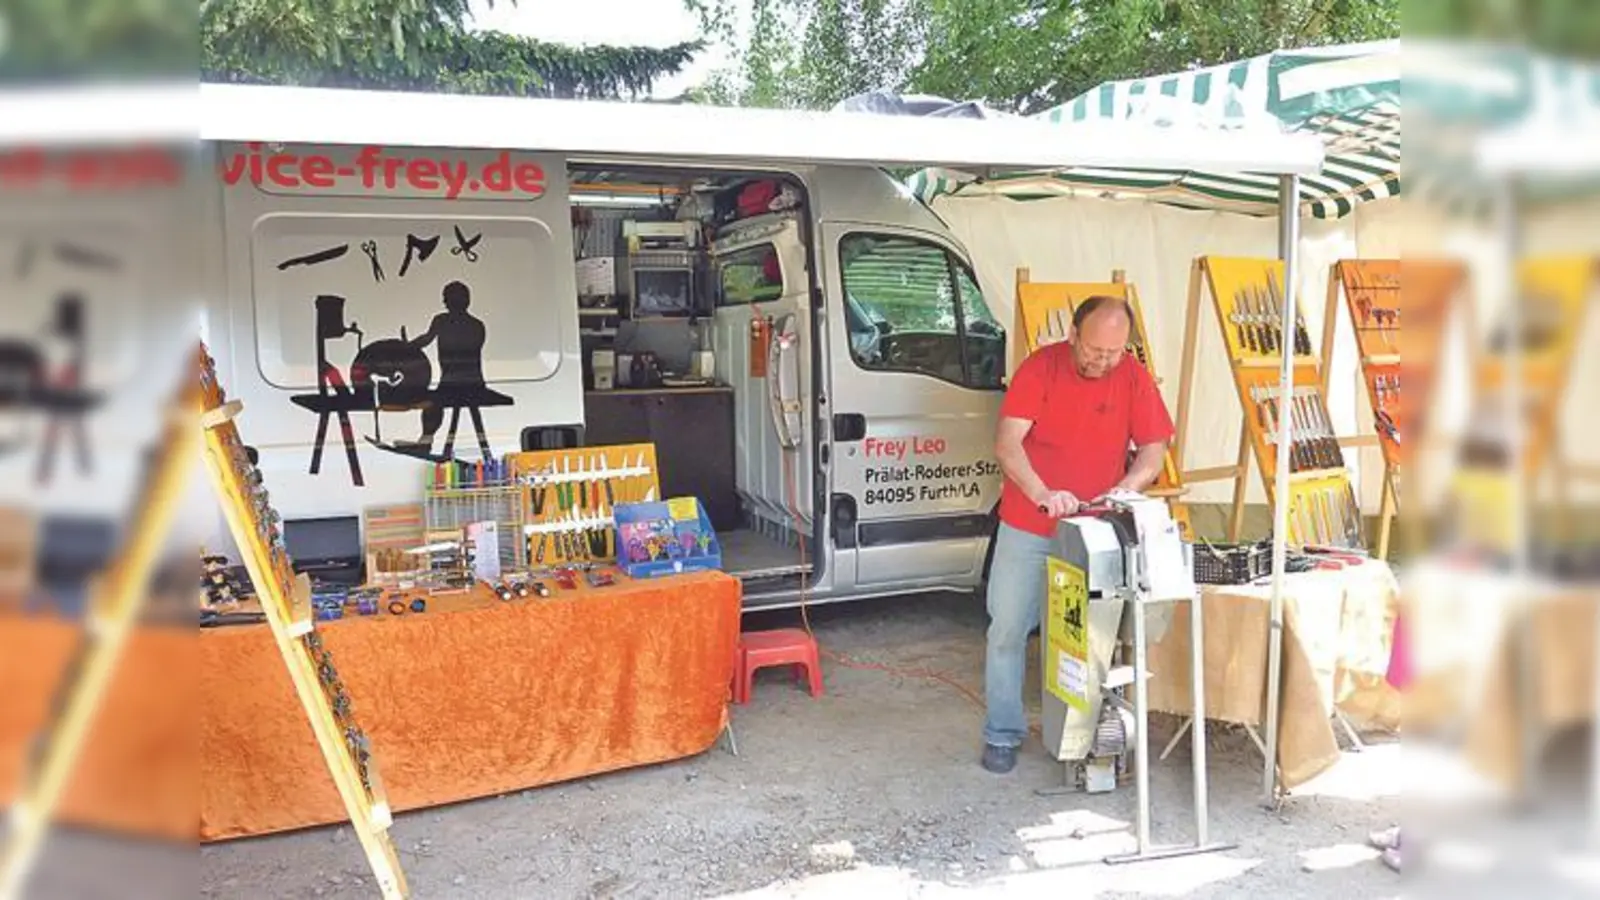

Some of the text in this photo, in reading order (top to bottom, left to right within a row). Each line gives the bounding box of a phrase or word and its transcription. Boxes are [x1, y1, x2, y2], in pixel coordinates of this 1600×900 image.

[864, 436, 947, 460] Frey Leo
[865, 460, 1001, 483] Prälat-Roderer-Str.
[865, 486, 915, 505] 84095
